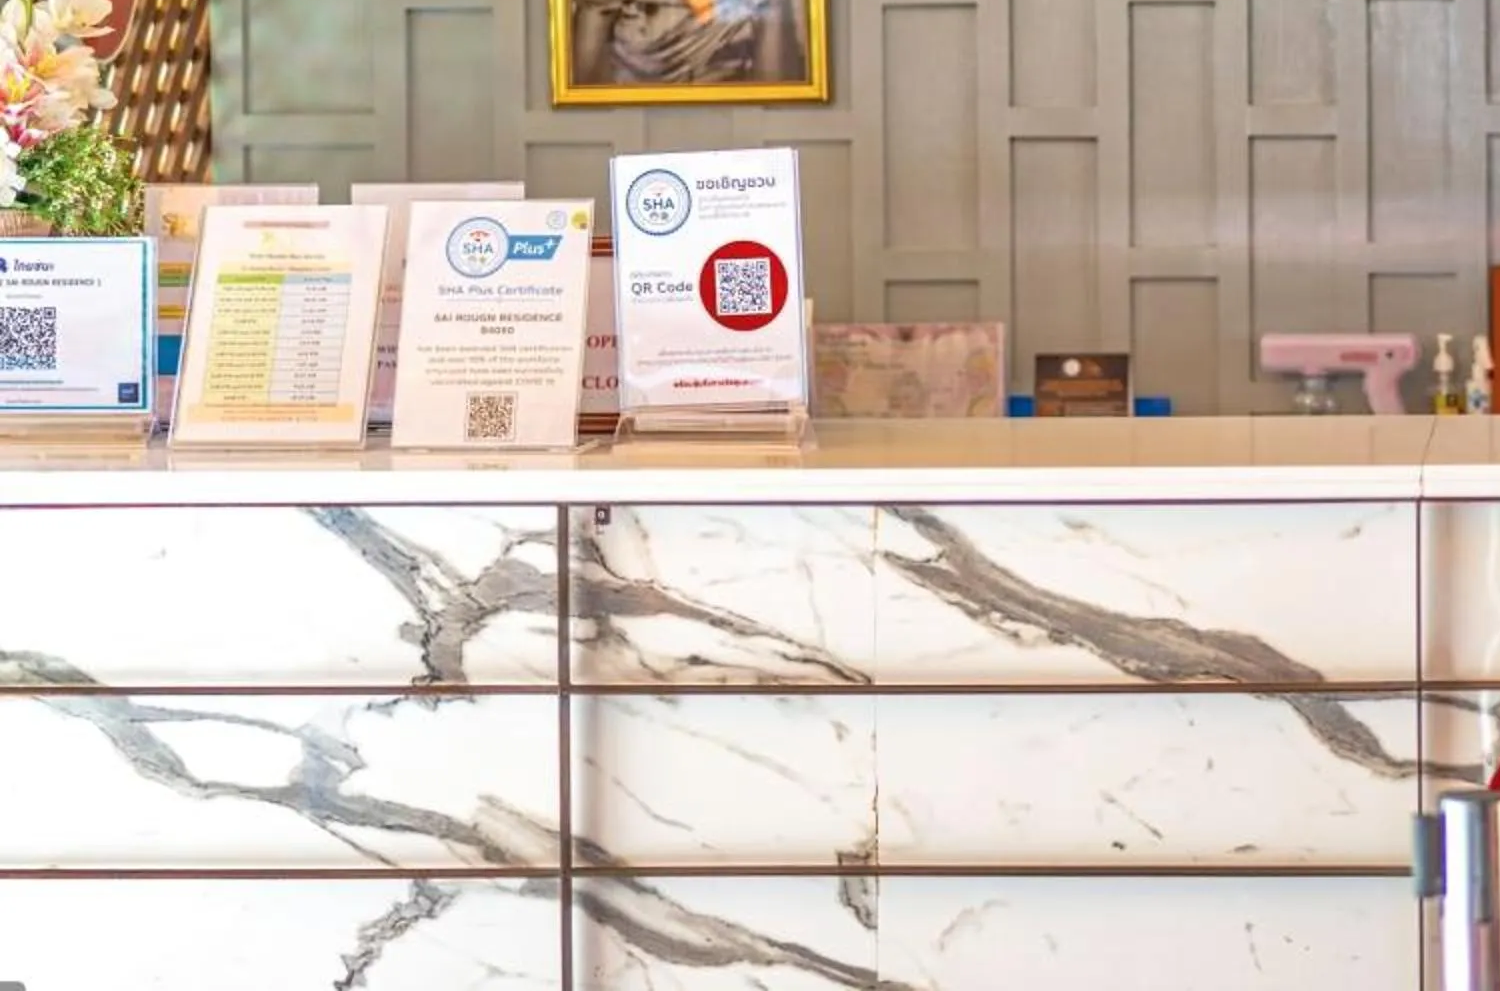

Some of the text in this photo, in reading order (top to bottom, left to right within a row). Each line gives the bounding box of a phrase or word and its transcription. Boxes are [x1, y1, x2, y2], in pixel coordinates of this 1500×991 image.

[696, 175, 775, 191] ขอเชิญชวน
[643, 197, 675, 211] SHA
[462, 242, 494, 254] SHA
[498, 285, 563, 295] Certificate
[631, 282, 693, 295] QR Code
